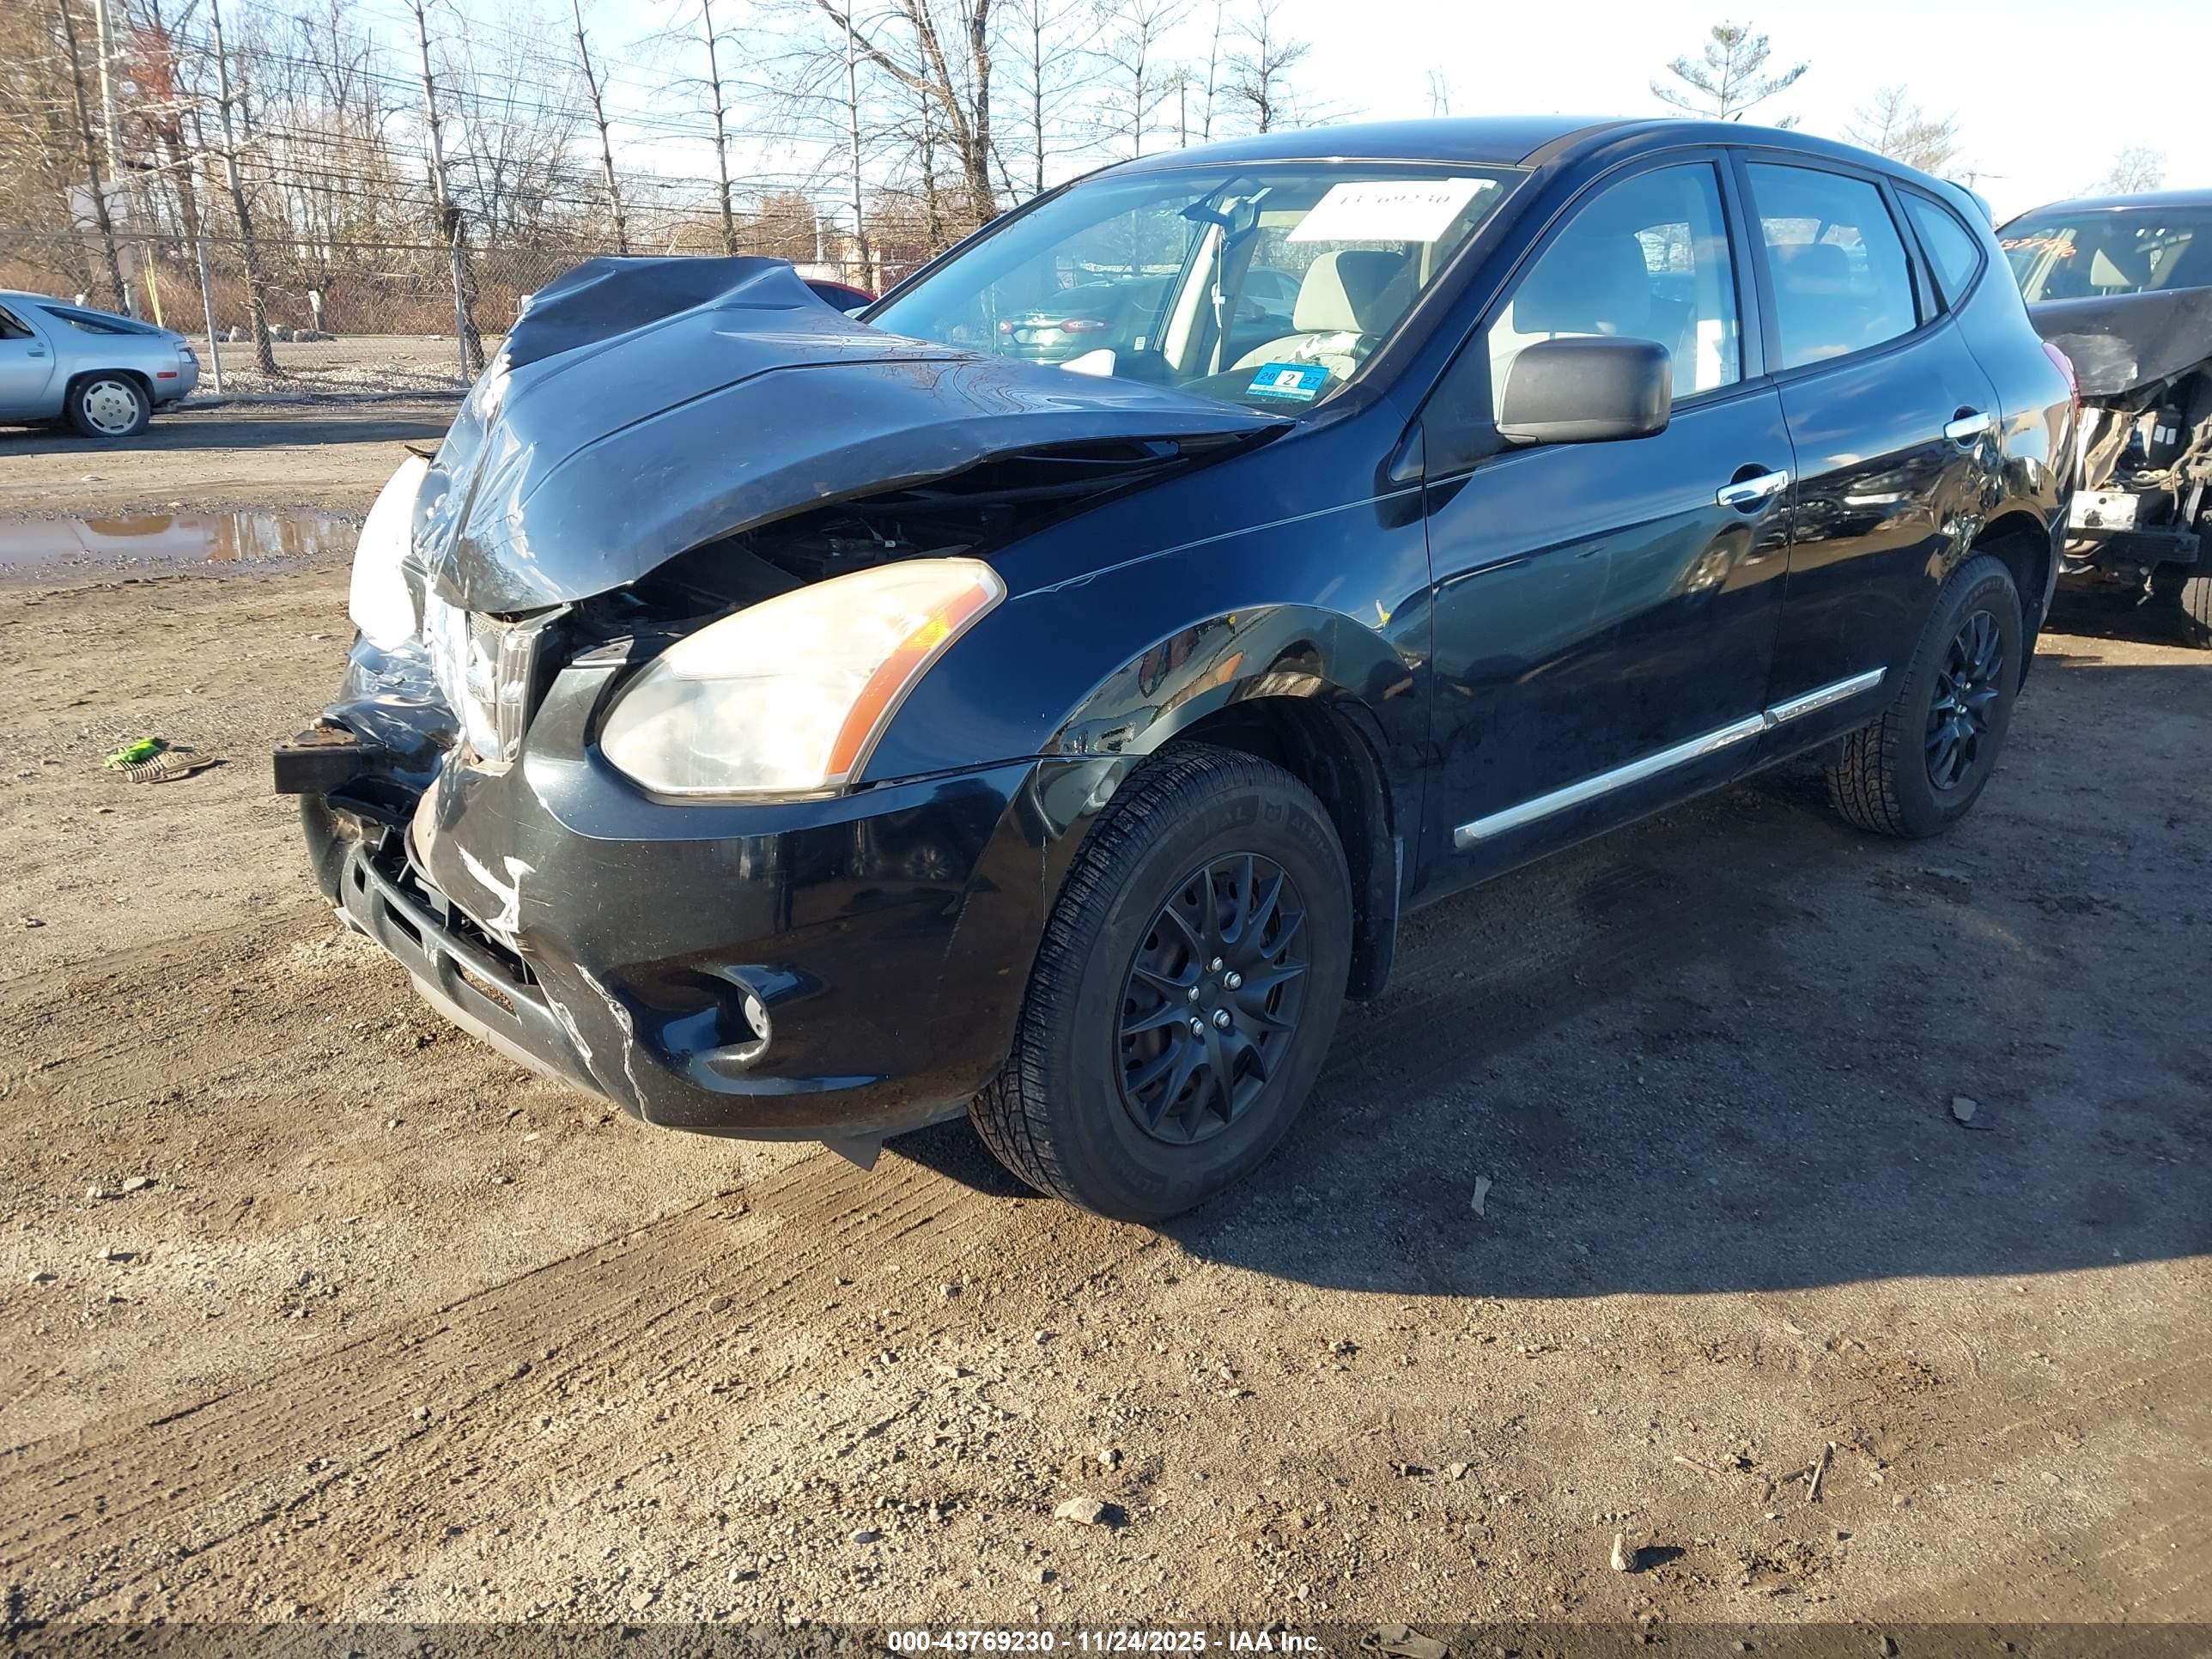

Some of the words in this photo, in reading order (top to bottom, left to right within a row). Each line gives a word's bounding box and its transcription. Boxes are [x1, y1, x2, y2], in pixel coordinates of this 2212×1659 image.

[1260, 372, 1276, 380] 20
[1283, 374, 1296, 386] 2
[1303, 376, 1320, 385] 27
